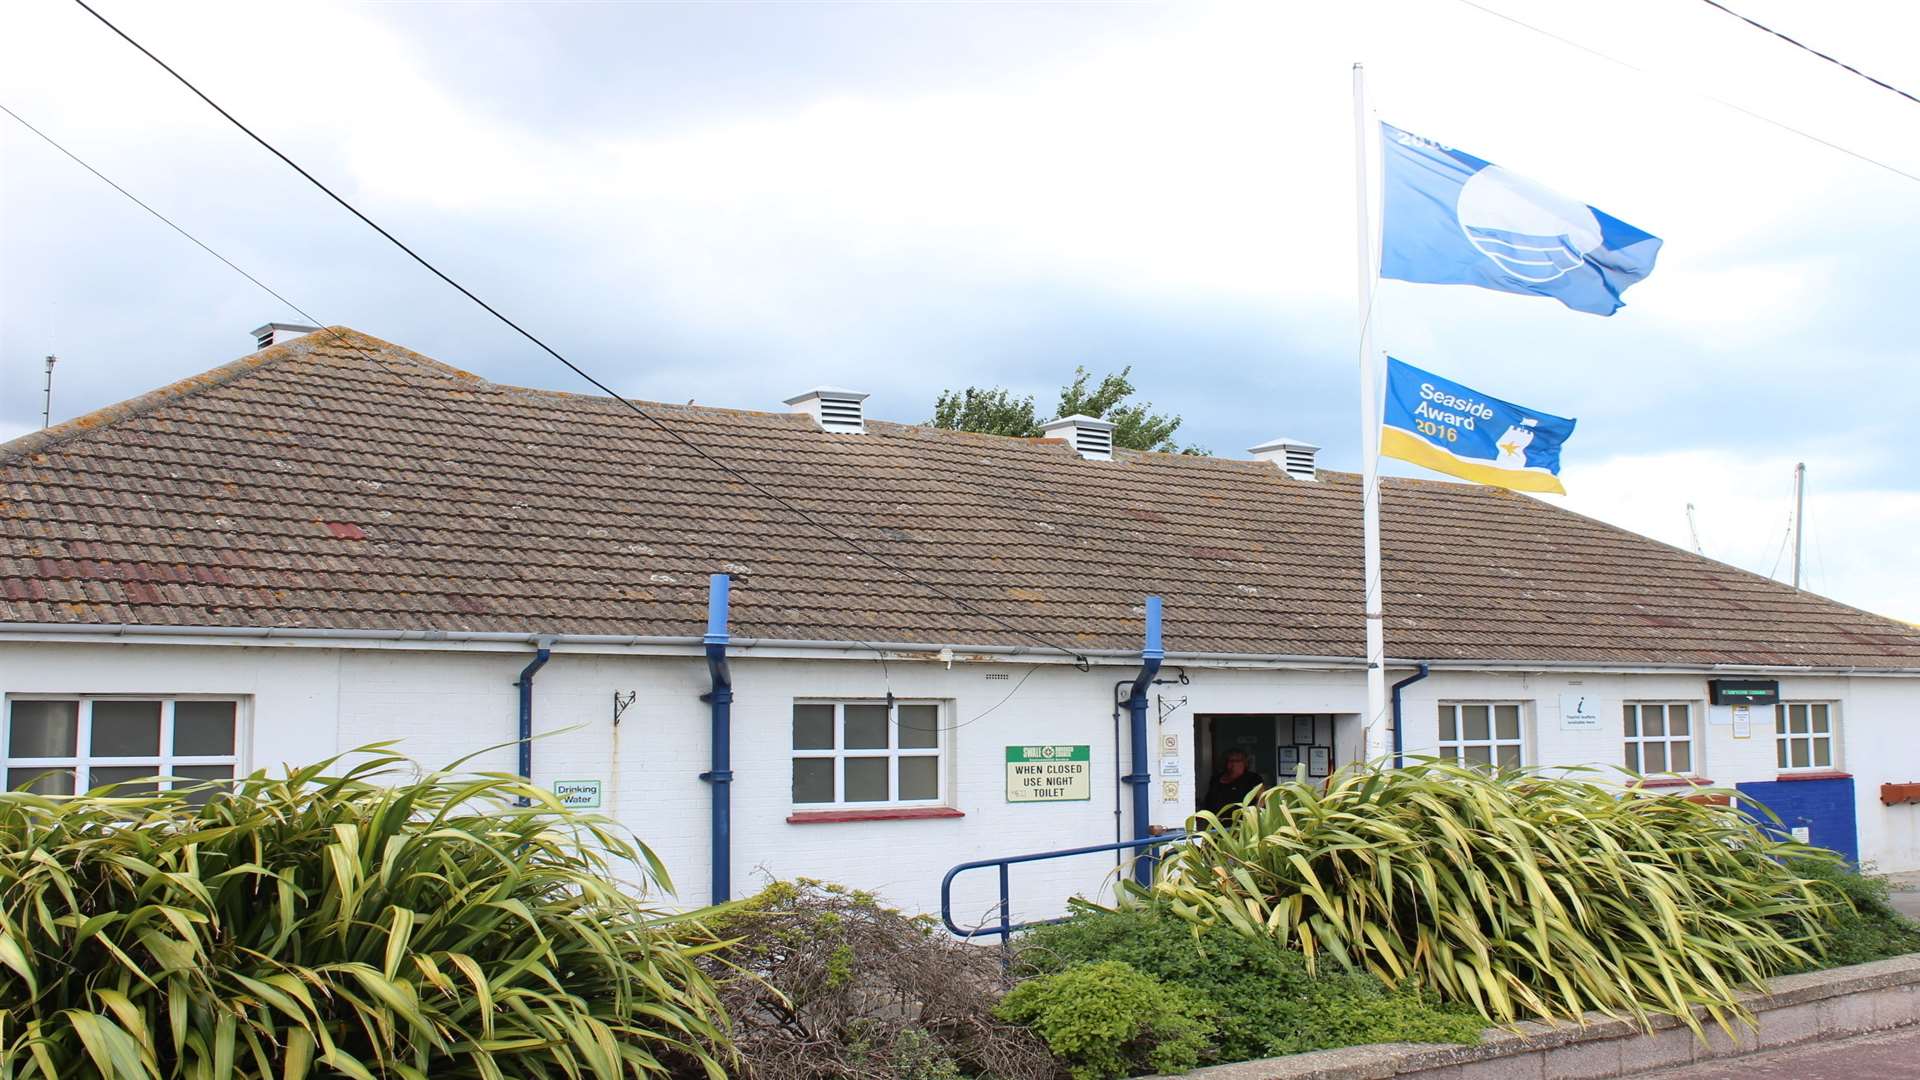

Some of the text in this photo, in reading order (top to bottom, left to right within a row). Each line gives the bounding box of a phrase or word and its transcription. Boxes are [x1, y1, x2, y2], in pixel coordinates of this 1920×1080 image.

[1419, 383, 1494, 420] Seaside
[1414, 401, 1475, 431] Award
[1415, 419, 1458, 442] 2016
[1015, 764, 1082, 774] WHEN CLOSED
[1023, 776, 1073, 787] USE NIGHT
[558, 785, 597, 794] Drinking
[1033, 788, 1065, 798] TOILET
